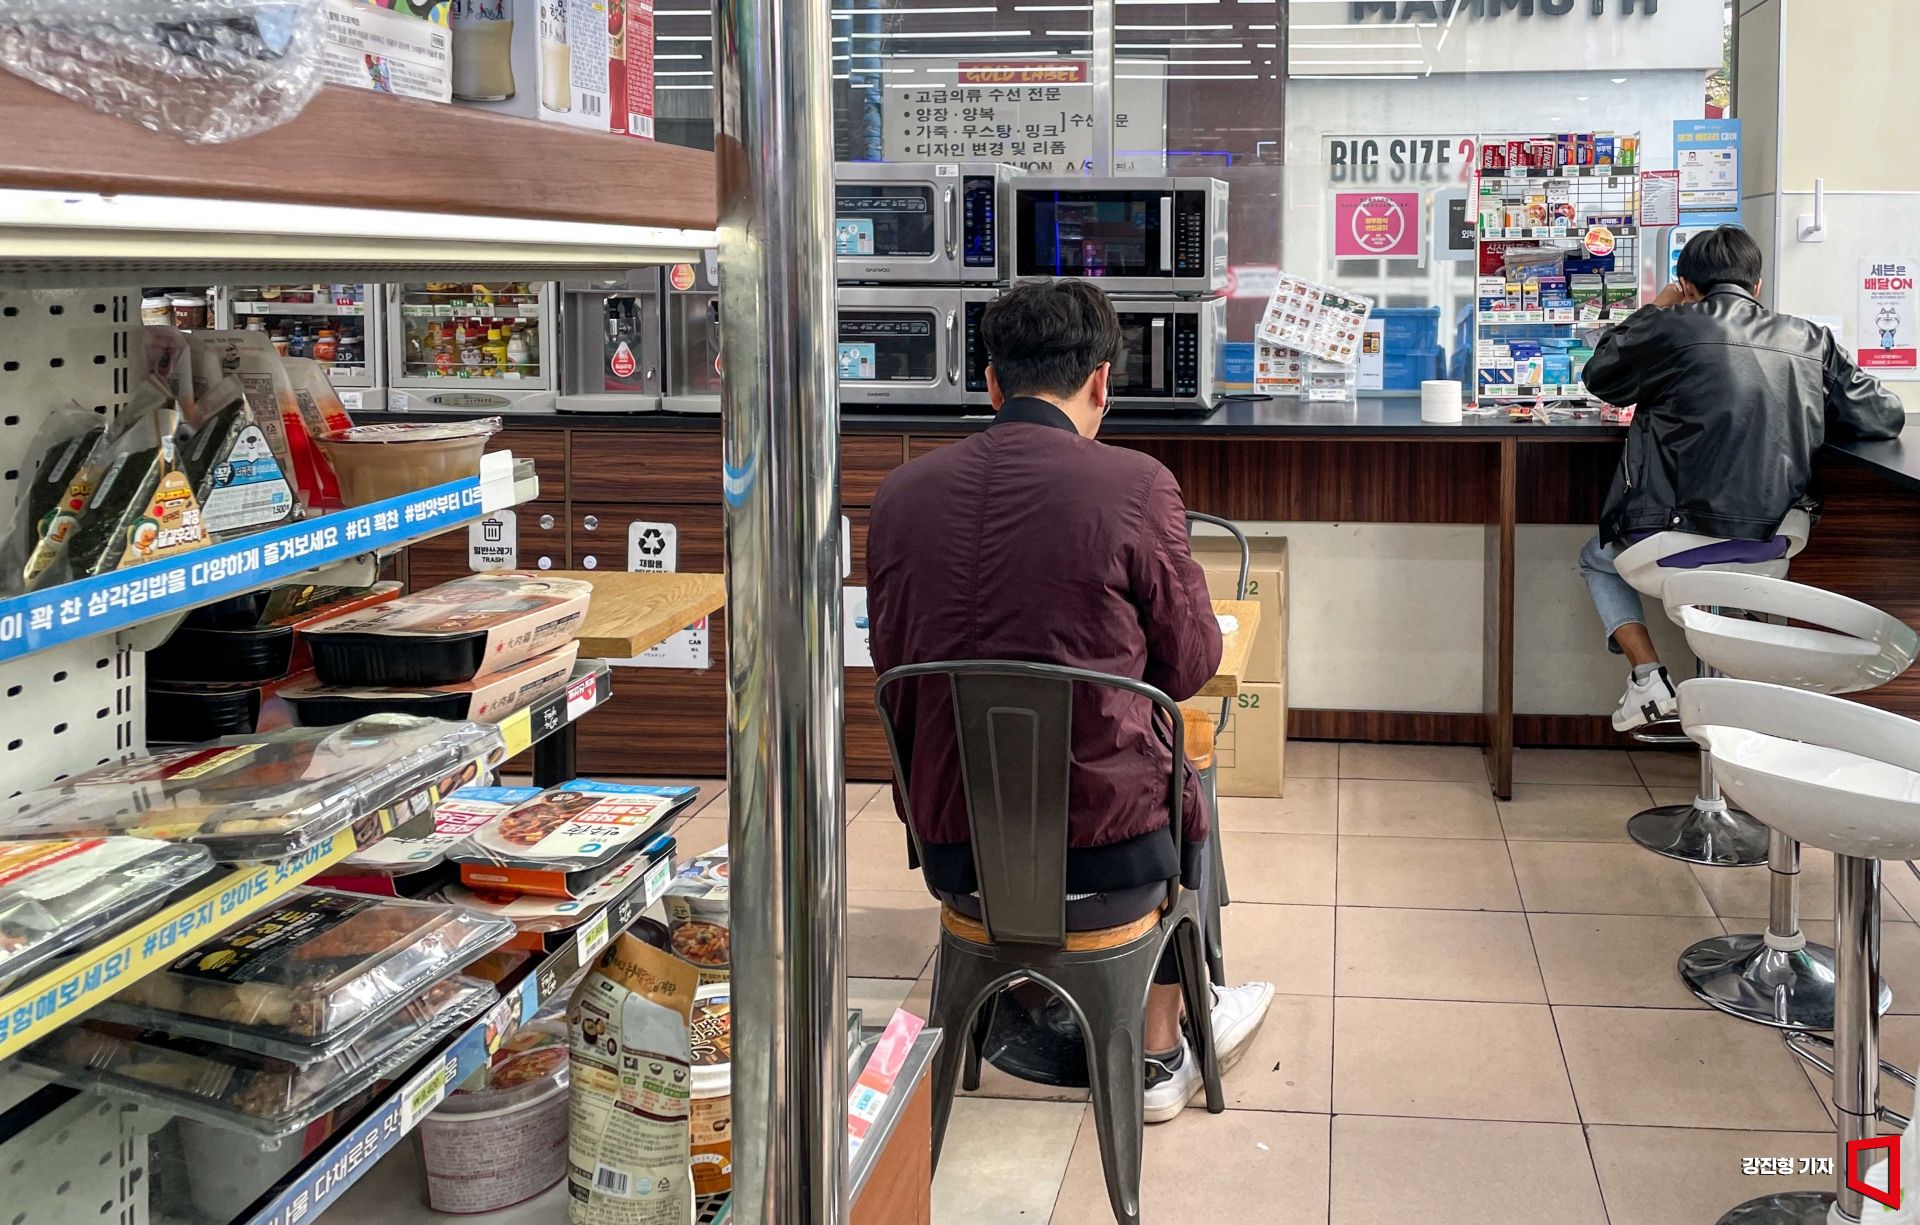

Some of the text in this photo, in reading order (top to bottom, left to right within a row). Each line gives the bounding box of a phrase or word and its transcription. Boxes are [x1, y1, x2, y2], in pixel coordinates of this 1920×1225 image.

[965, 65, 1017, 82] GOLD
[915, 88, 1061, 104] 고급의류 수선 전문
[916, 108, 995, 122] 양장 양복
[916, 124, 1058, 139] 가죽 무스탕 밍크
[916, 141, 1066, 156] 디자인 변경 및 리폼
[1331, 140, 1379, 182] BIG
[1390, 140, 1450, 182] SIZE
[1871, 264, 1906, 276] 세븐은
[1864, 277, 1913, 290] 배달ON
[474, 546, 513, 556] 일반쓰레기
[30, 605, 53, 630] 꽉
[60, 597, 82, 625] 찬
[88, 568, 187, 617] 삼각김밥을
[192, 547, 260, 587] 다양하게
[264, 527, 338, 566] 즐겨보세요
[346, 516, 371, 541] #더
[374, 509, 399, 532] 꽉찬
[405, 492, 459, 523] #밥맛부터
[639, 559, 663, 569] 재활용
[1238, 694, 1260, 708] S2
[142, 901, 214, 960] #데우지
[219, 869, 268, 916] 않아도
[314, 1127, 379, 1203] 다채로운
